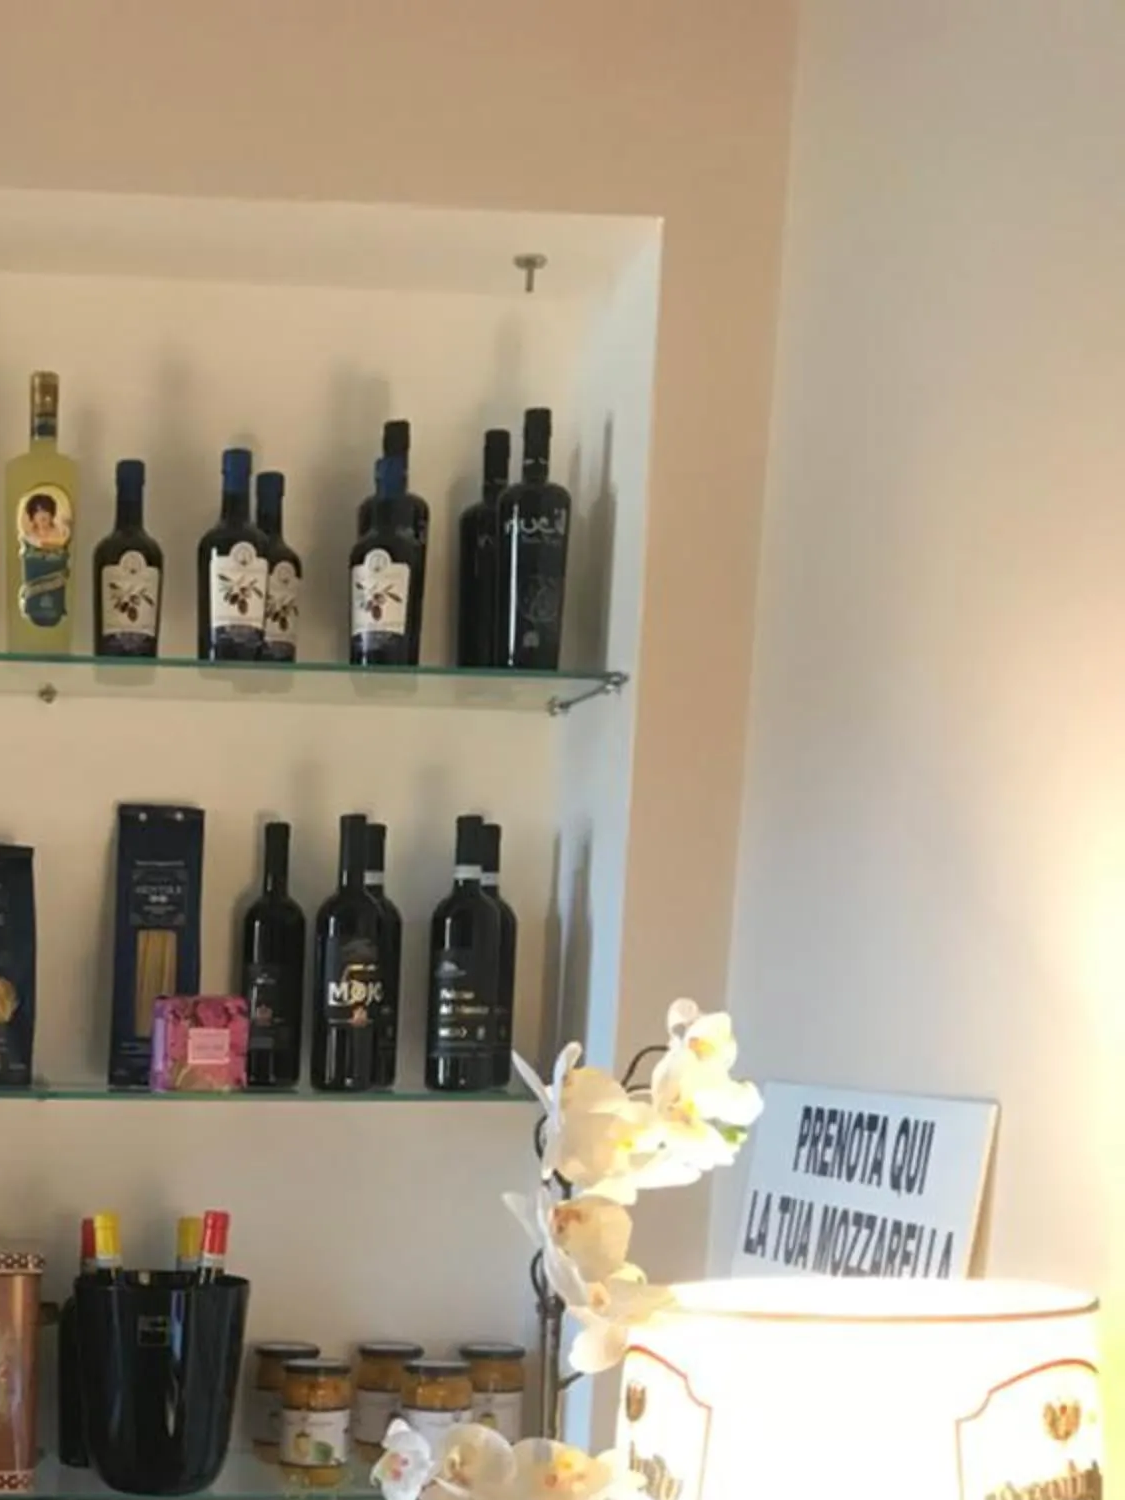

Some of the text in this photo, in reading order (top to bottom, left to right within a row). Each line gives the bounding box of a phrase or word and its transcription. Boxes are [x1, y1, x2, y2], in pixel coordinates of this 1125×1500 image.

[792, 1105, 936, 1197] PRENOTA QUI
[743, 1189, 954, 1279] LA TUA MOZZARELLA
